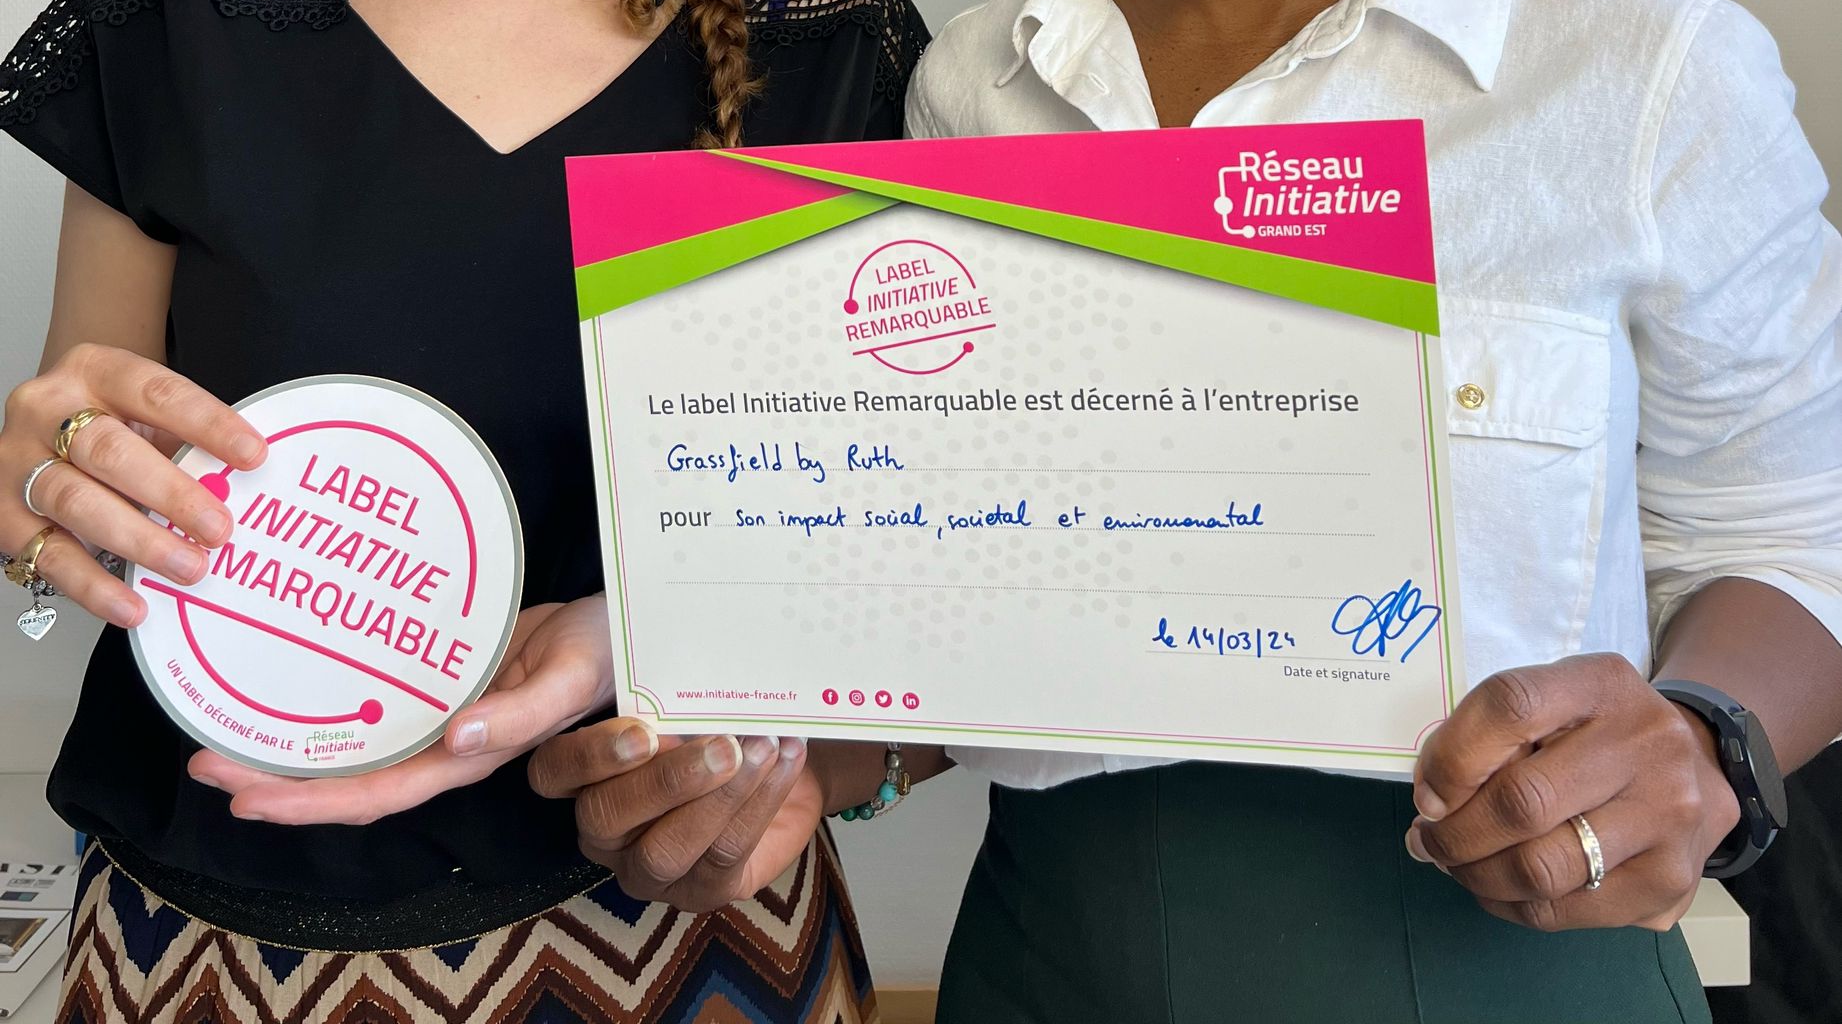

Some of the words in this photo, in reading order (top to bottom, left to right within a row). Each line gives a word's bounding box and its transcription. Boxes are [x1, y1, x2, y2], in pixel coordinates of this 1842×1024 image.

[1239, 150, 1363, 182] Réseau
[1243, 183, 1401, 217] Initiative
[1258, 225, 1302, 237] GRAND
[1305, 224, 1327, 236] EST
[876, 258, 935, 285] LABEL
[867, 277, 959, 312] INITIATIVE
[846, 297, 991, 341] REMARQUABLE
[649, 394, 674, 415] Le
[680, 393, 735, 414] label
[743, 391, 846, 413] Initiative
[854, 389, 1017, 417] Remarquable
[1024, 391, 1064, 411] est
[1071, 387, 1173, 411] décerné
[1182, 388, 1196, 411] à
[667, 442, 782, 483] Grassfield
[795, 442, 826, 483] by
[847, 443, 905, 471] Ruth
[299, 455, 419, 535] LABEL
[660, 510, 711, 532] pour
[778, 506, 846, 537] impact
[1058, 506, 1086, 527] et
[238, 493, 450, 603] INITIATIVE
[206, 540, 472, 680] MARQUABLE
[1152, 617, 1178, 648] le
[1284, 665, 1312, 677] Date
[1316, 667, 1328, 678] et
[1331, 668, 1391, 682] signature
[167, 659, 182, 678] UN
[178, 676, 205, 708] LABEL
[204, 703, 254, 738] DÉCERNÉ
[254, 732, 278, 748] PAR
[280, 739, 294, 751] LE
[676, 688, 797, 701] www.initiative-france.fr
[314, 730, 354, 742] Réseau
[314, 739, 365, 754] Initiative
